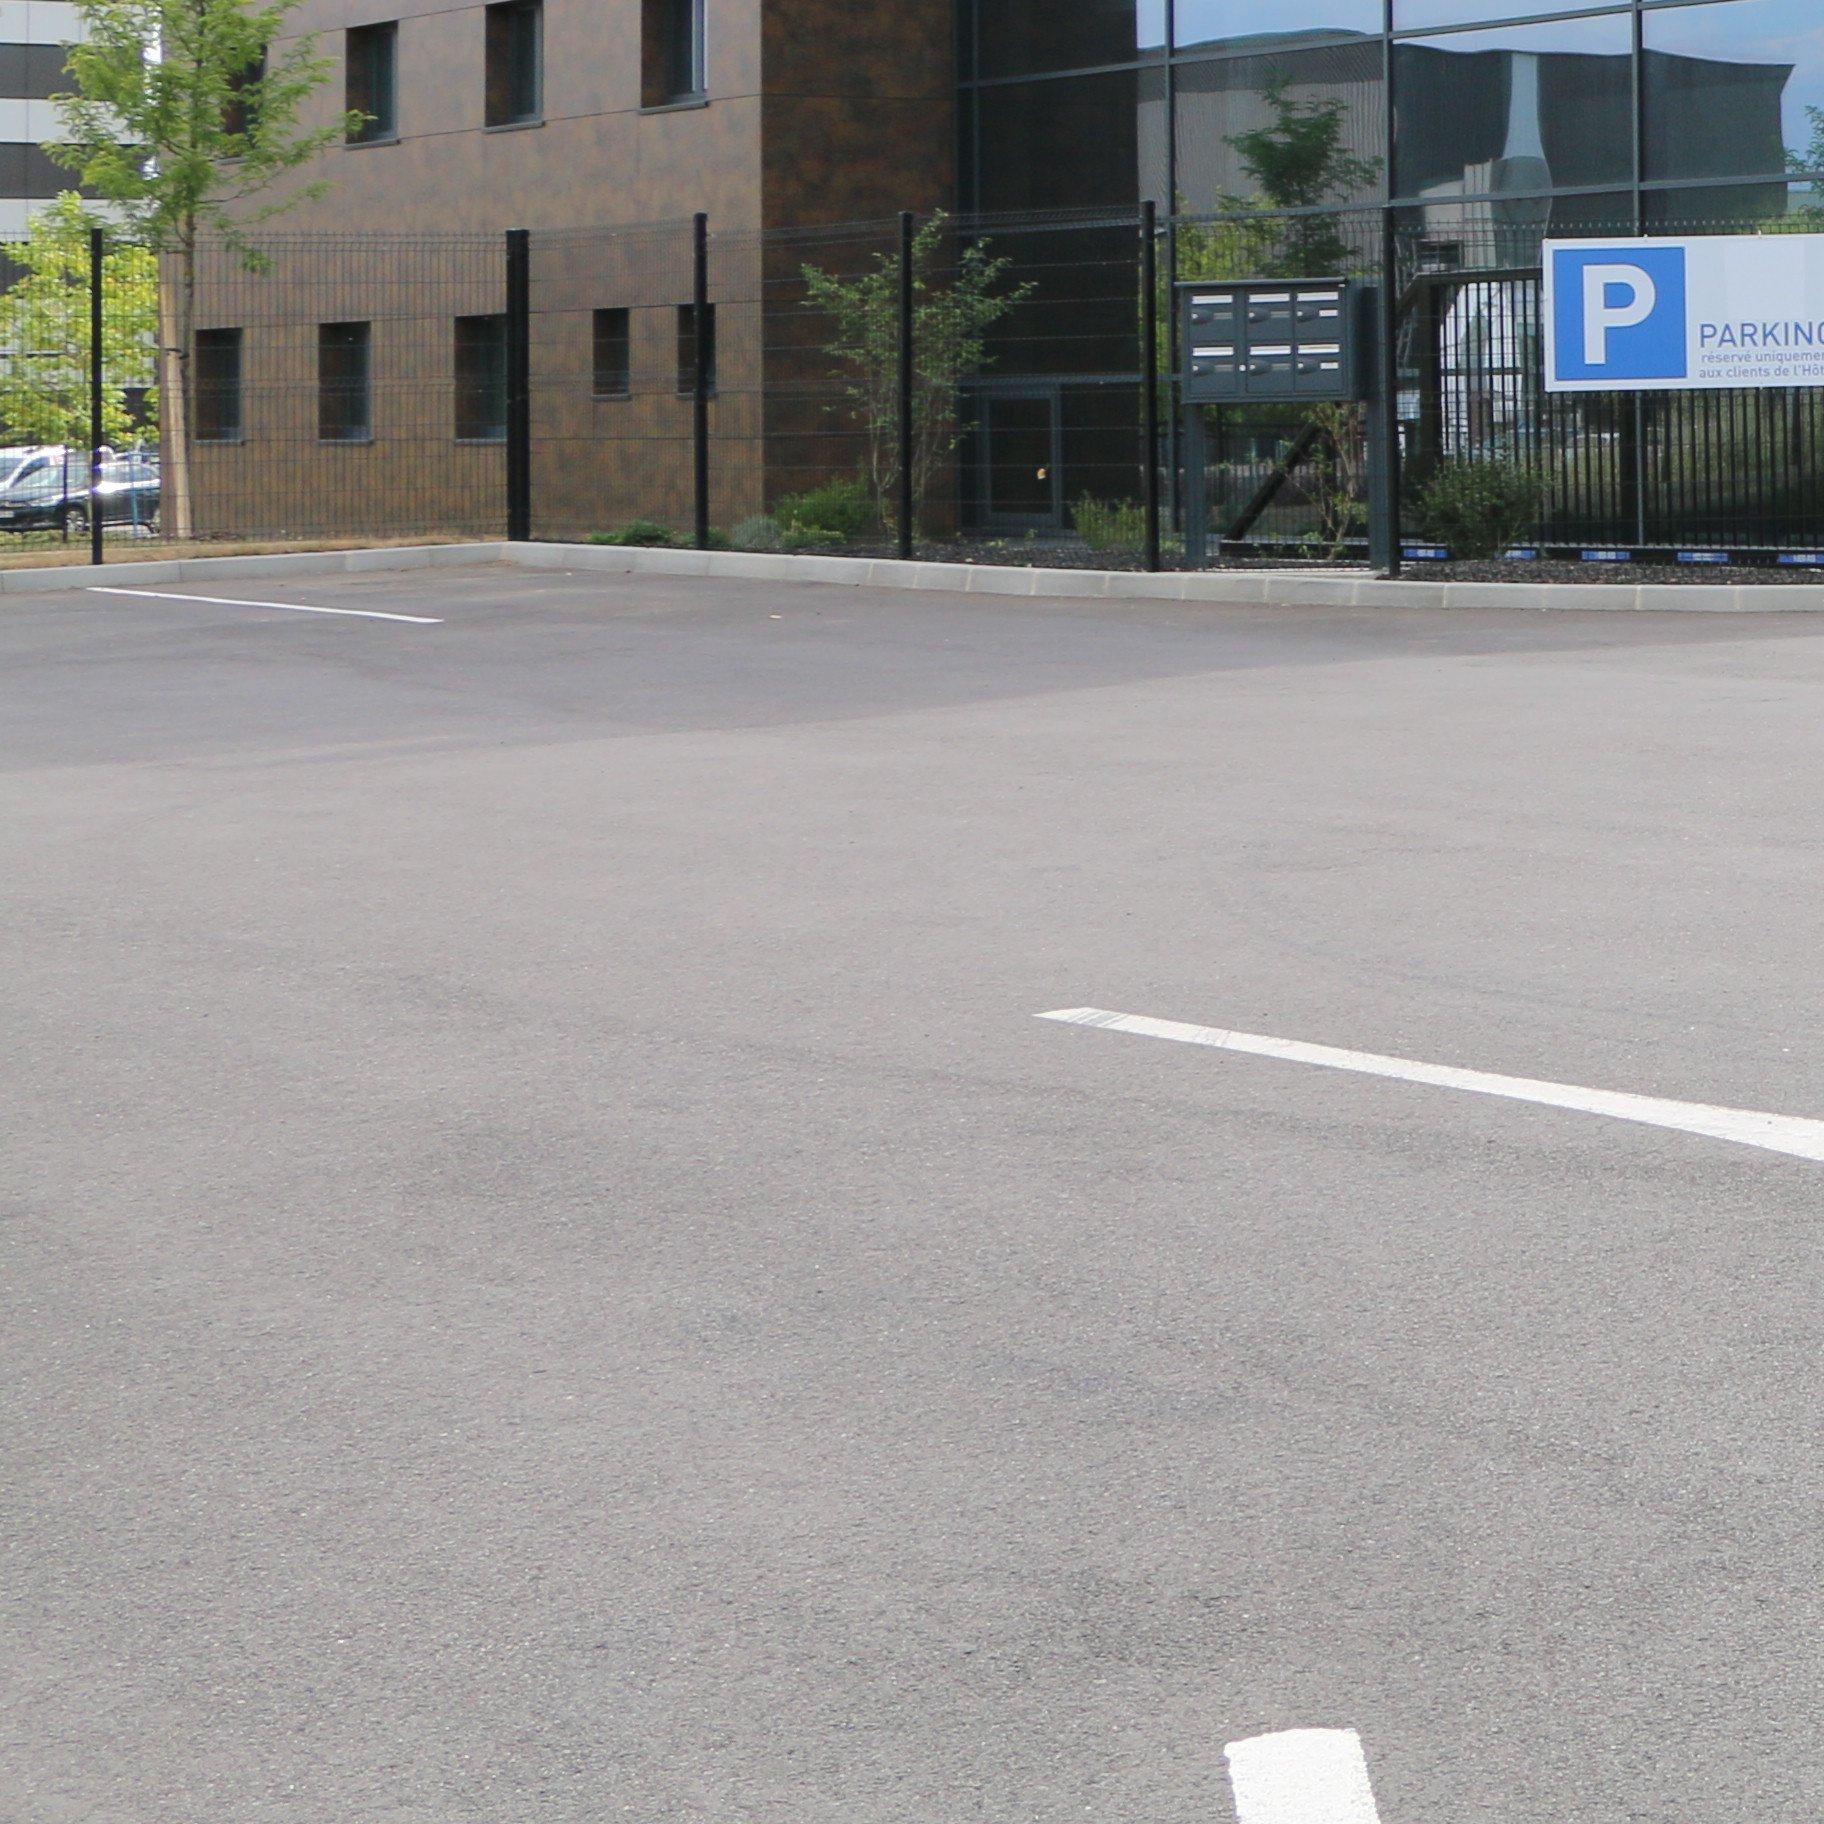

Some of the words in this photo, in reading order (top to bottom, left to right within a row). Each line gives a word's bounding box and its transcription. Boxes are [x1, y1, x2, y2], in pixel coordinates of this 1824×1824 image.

[1582, 263, 1656, 365] P
[1701, 351, 1751, 364] réservé
[1700, 368, 1724, 378] aux
[1726, 366, 1770, 377] clients
[1774, 365, 1790, 377] de
